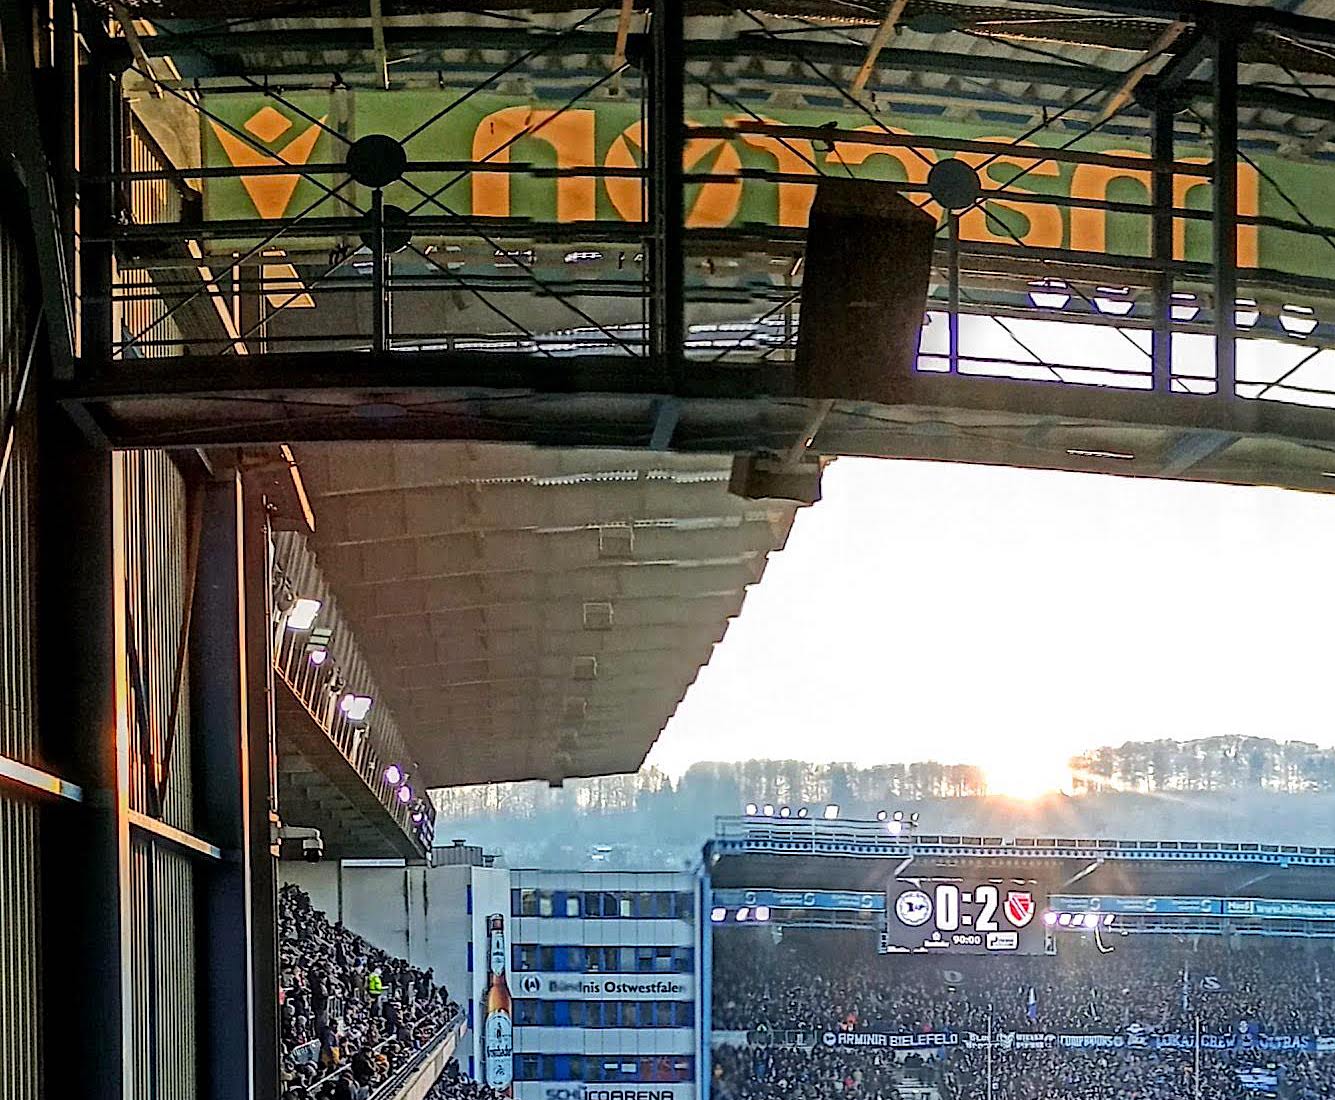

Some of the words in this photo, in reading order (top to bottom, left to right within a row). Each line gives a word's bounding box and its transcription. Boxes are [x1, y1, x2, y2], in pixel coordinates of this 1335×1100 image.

[936, 884, 999, 932] 0:2
[953, 935, 981, 945] 90:00
[838, 1033, 887, 1046] ARMINIA
